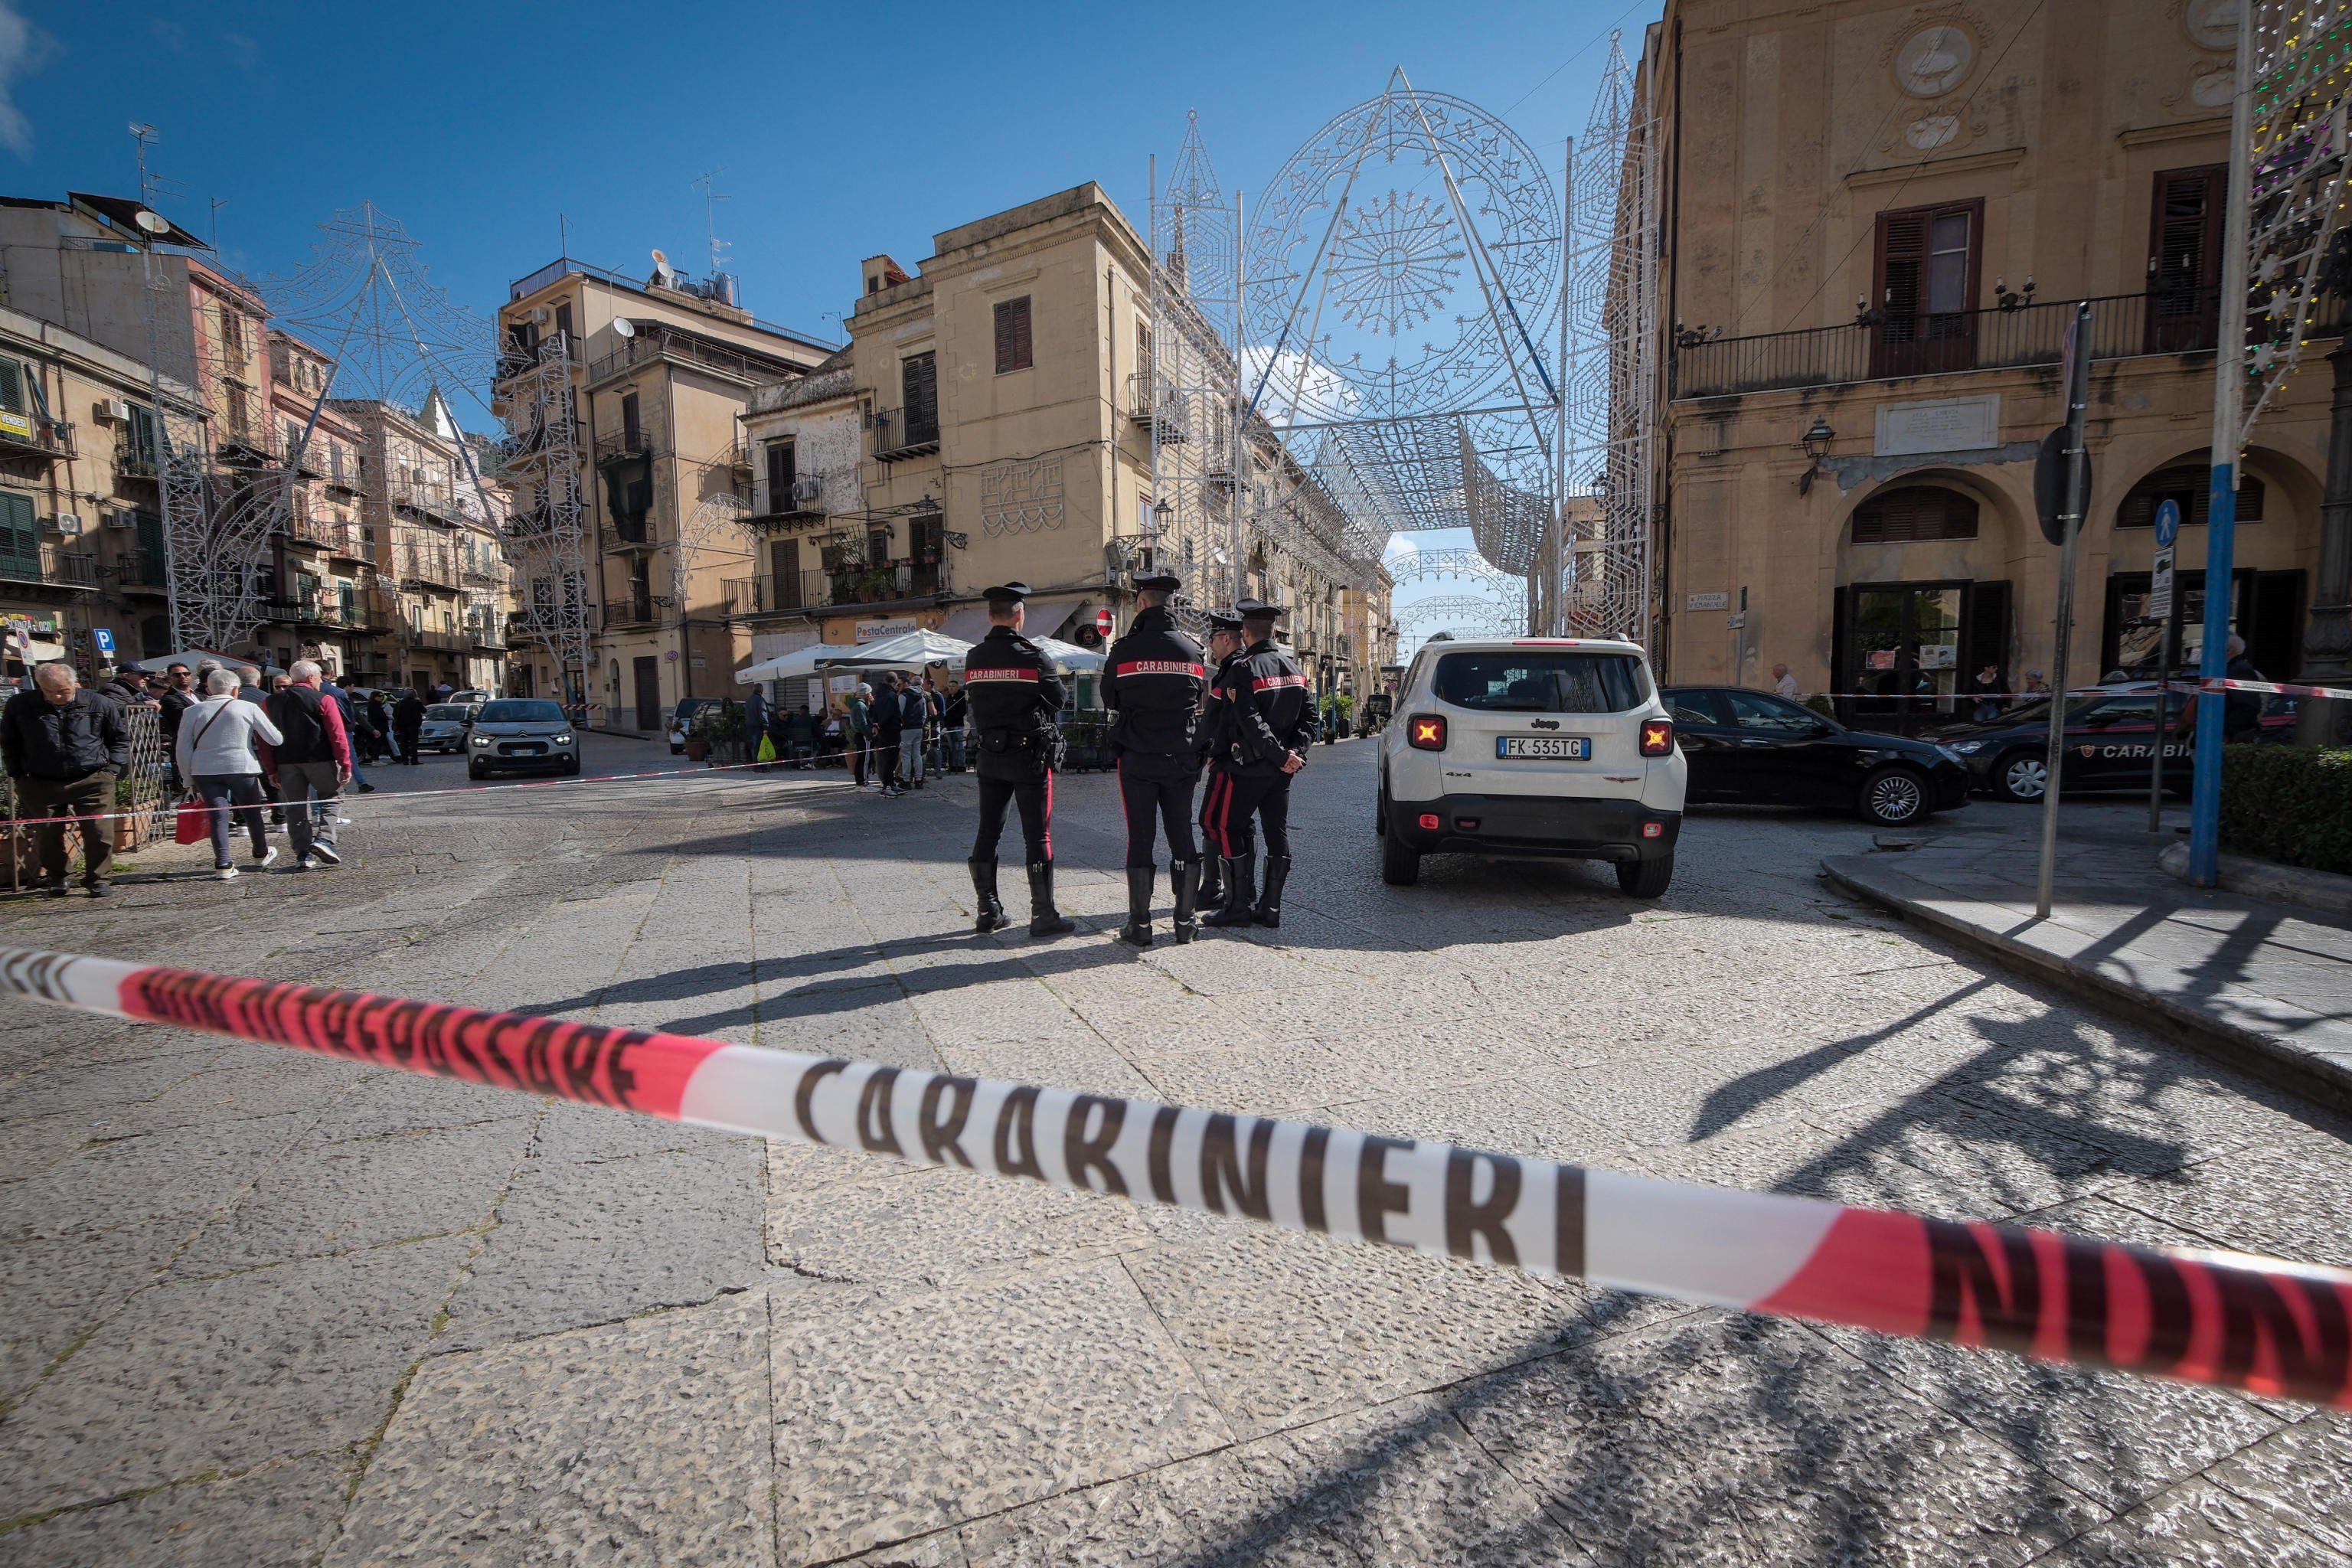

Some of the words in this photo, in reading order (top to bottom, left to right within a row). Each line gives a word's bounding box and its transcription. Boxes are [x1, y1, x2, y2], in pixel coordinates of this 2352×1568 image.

[98, 632, 109, 648] P
[1136, 661, 1194, 673] CARABINIERI
[969, 669, 1019, 680] CARABINIERI
[1531, 718, 1560, 730] Jeep
[1508, 740, 1526, 754] FK
[1533, 740, 1579, 755] 535TG
[2102, 744, 2192, 758] CARABI
[792, 1060, 1586, 1278] CARABINIERI
